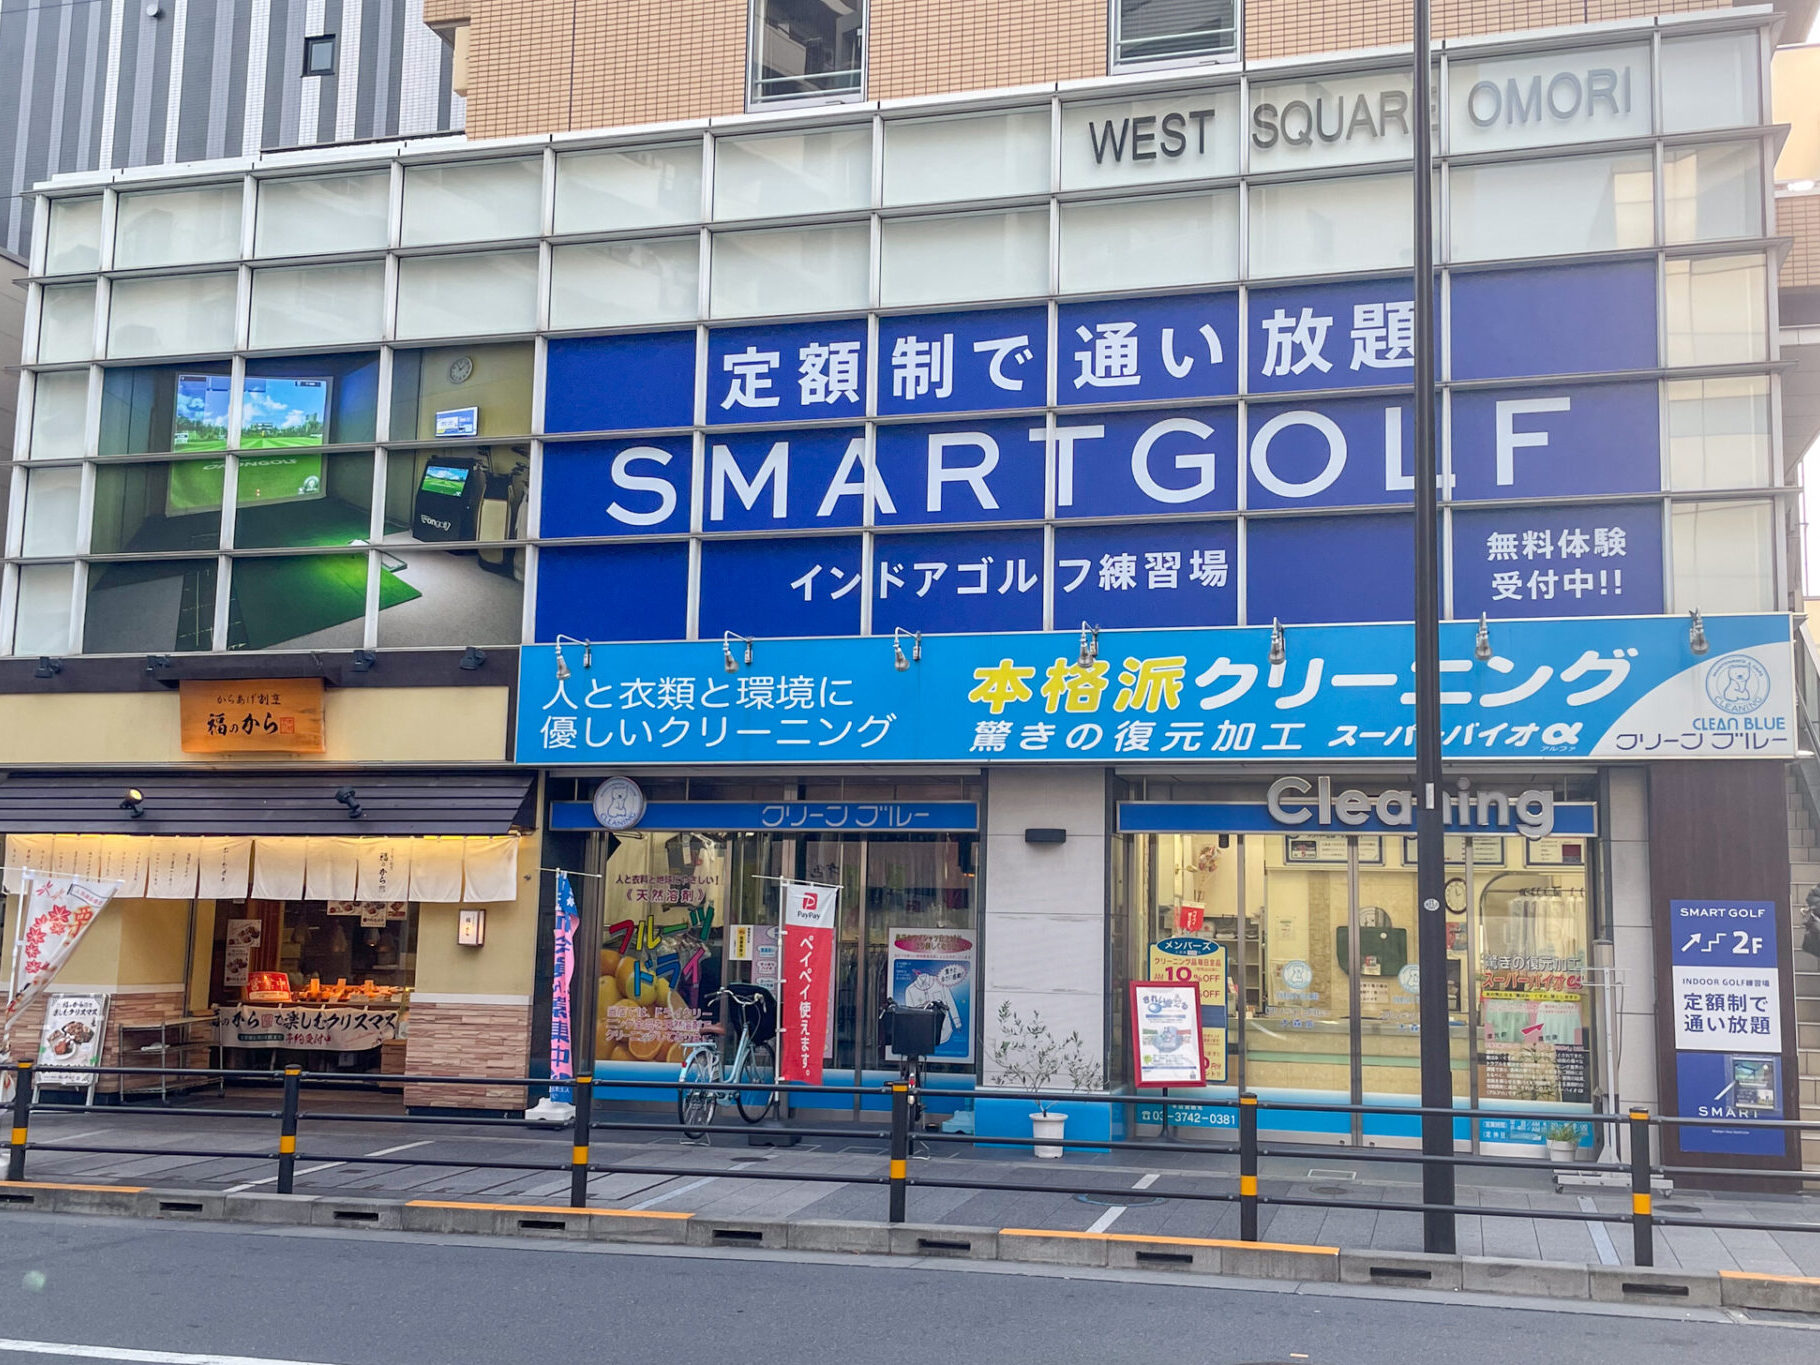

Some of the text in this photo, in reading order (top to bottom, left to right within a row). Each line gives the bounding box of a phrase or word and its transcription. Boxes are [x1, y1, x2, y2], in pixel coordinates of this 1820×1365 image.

[1089, 108, 1216, 165] WEST
[1467, 66, 1631, 128] OMORI
[720, 300, 1415, 411] 定額制で通い放題
[1486, 526, 1628, 561] 無料体験
[790, 549, 1229, 602] インドアゴルフ練習場
[1491, 568, 1623, 601] 受付中!!
[542, 675, 854, 711] 人と衣類と環境に
[968, 647, 1640, 714] 本格派クリーニング
[207, 712, 279, 736] 福のから
[540, 712, 898, 749] 優しいクリーニング
[968, 719, 1584, 753] 驚きの復元加工 スーパバイオα
[1692, 716, 1786, 731] CLEAN BLUE
[608, 902, 715, 955] フルーツ
[797, 910, 821, 921] PayPay
[1680, 907, 1766, 919] SMART GOLF
[1164, 940, 1212, 951] メンバーズ
[1732, 930, 1763, 954] 2F
[633, 946, 706, 998] ドライ
[1682, 978, 1719, 986] INDOOR
[799, 934, 815, 1077] ペイペイ使えます。
[1683, 993, 1769, 1013] 定額制で
[1683, 1014, 1771, 1035] 通い放題
